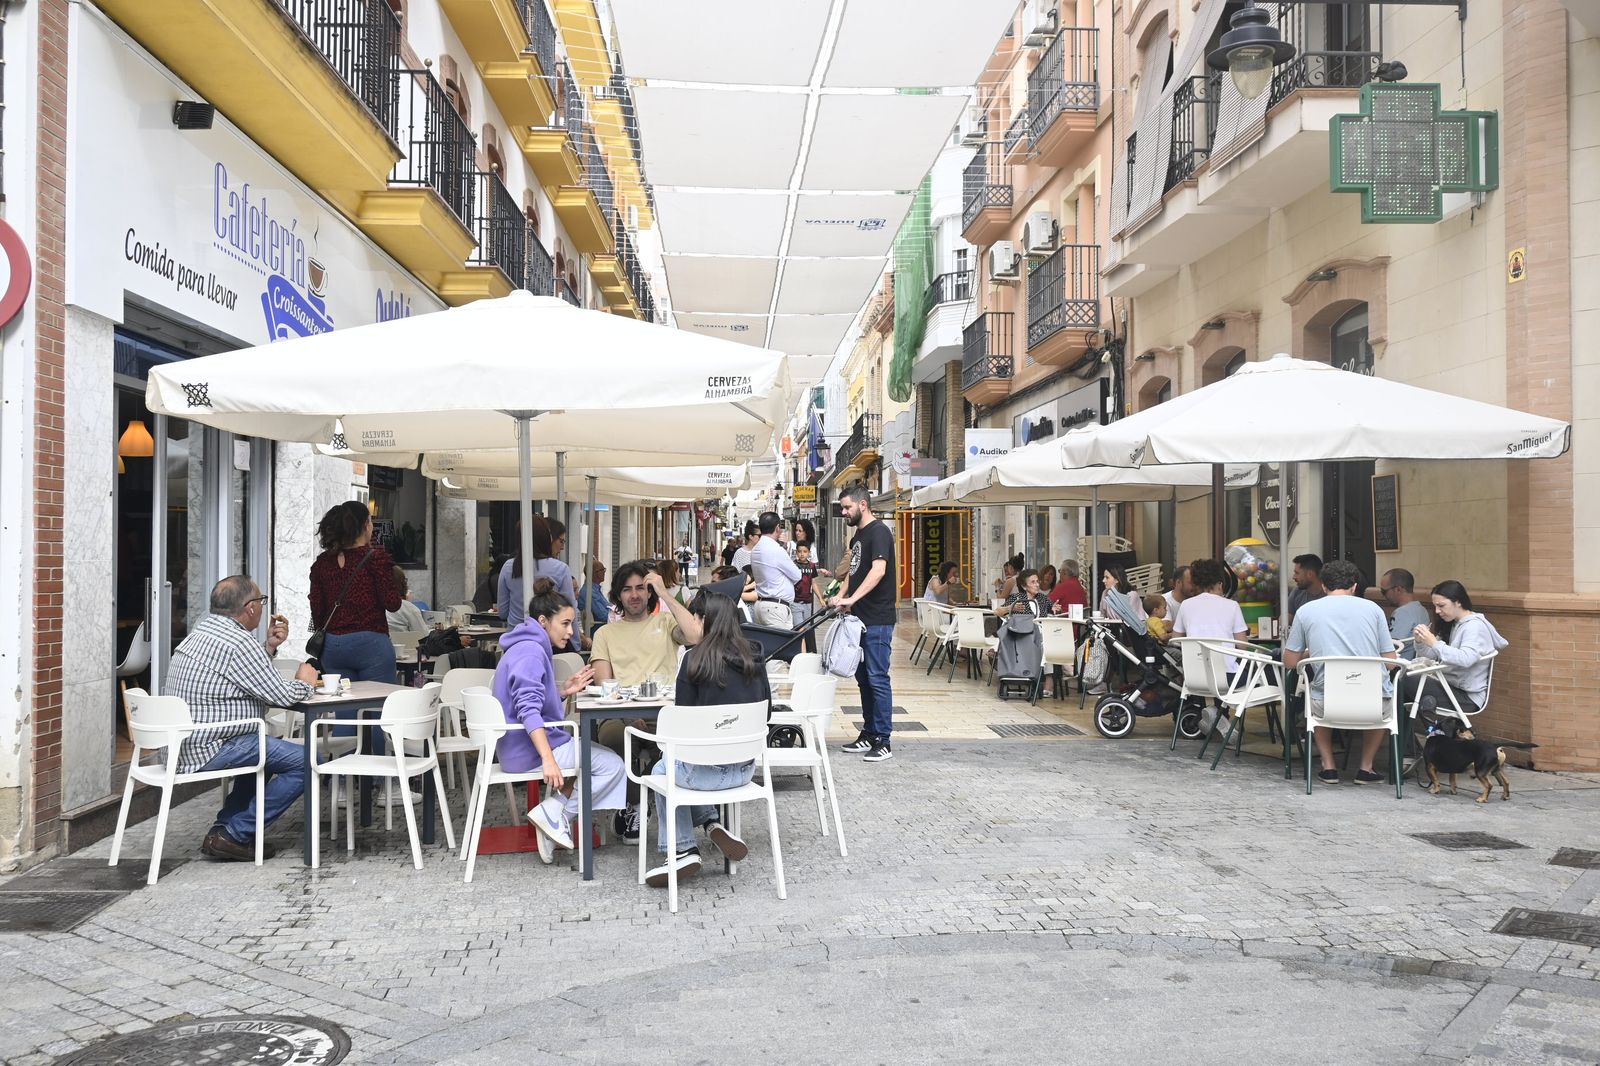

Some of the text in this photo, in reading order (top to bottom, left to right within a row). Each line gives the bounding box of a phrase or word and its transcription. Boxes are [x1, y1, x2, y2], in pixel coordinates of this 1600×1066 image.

[214, 162, 305, 289] Cafetería
[125, 228, 238, 311] Comida para llevar
[273, 286, 327, 336] Croissanter
[704, 384, 753, 398] ALHAMBRA
[708, 376, 752, 387] CERVEZAS
[925, 519, 940, 576] outlet
